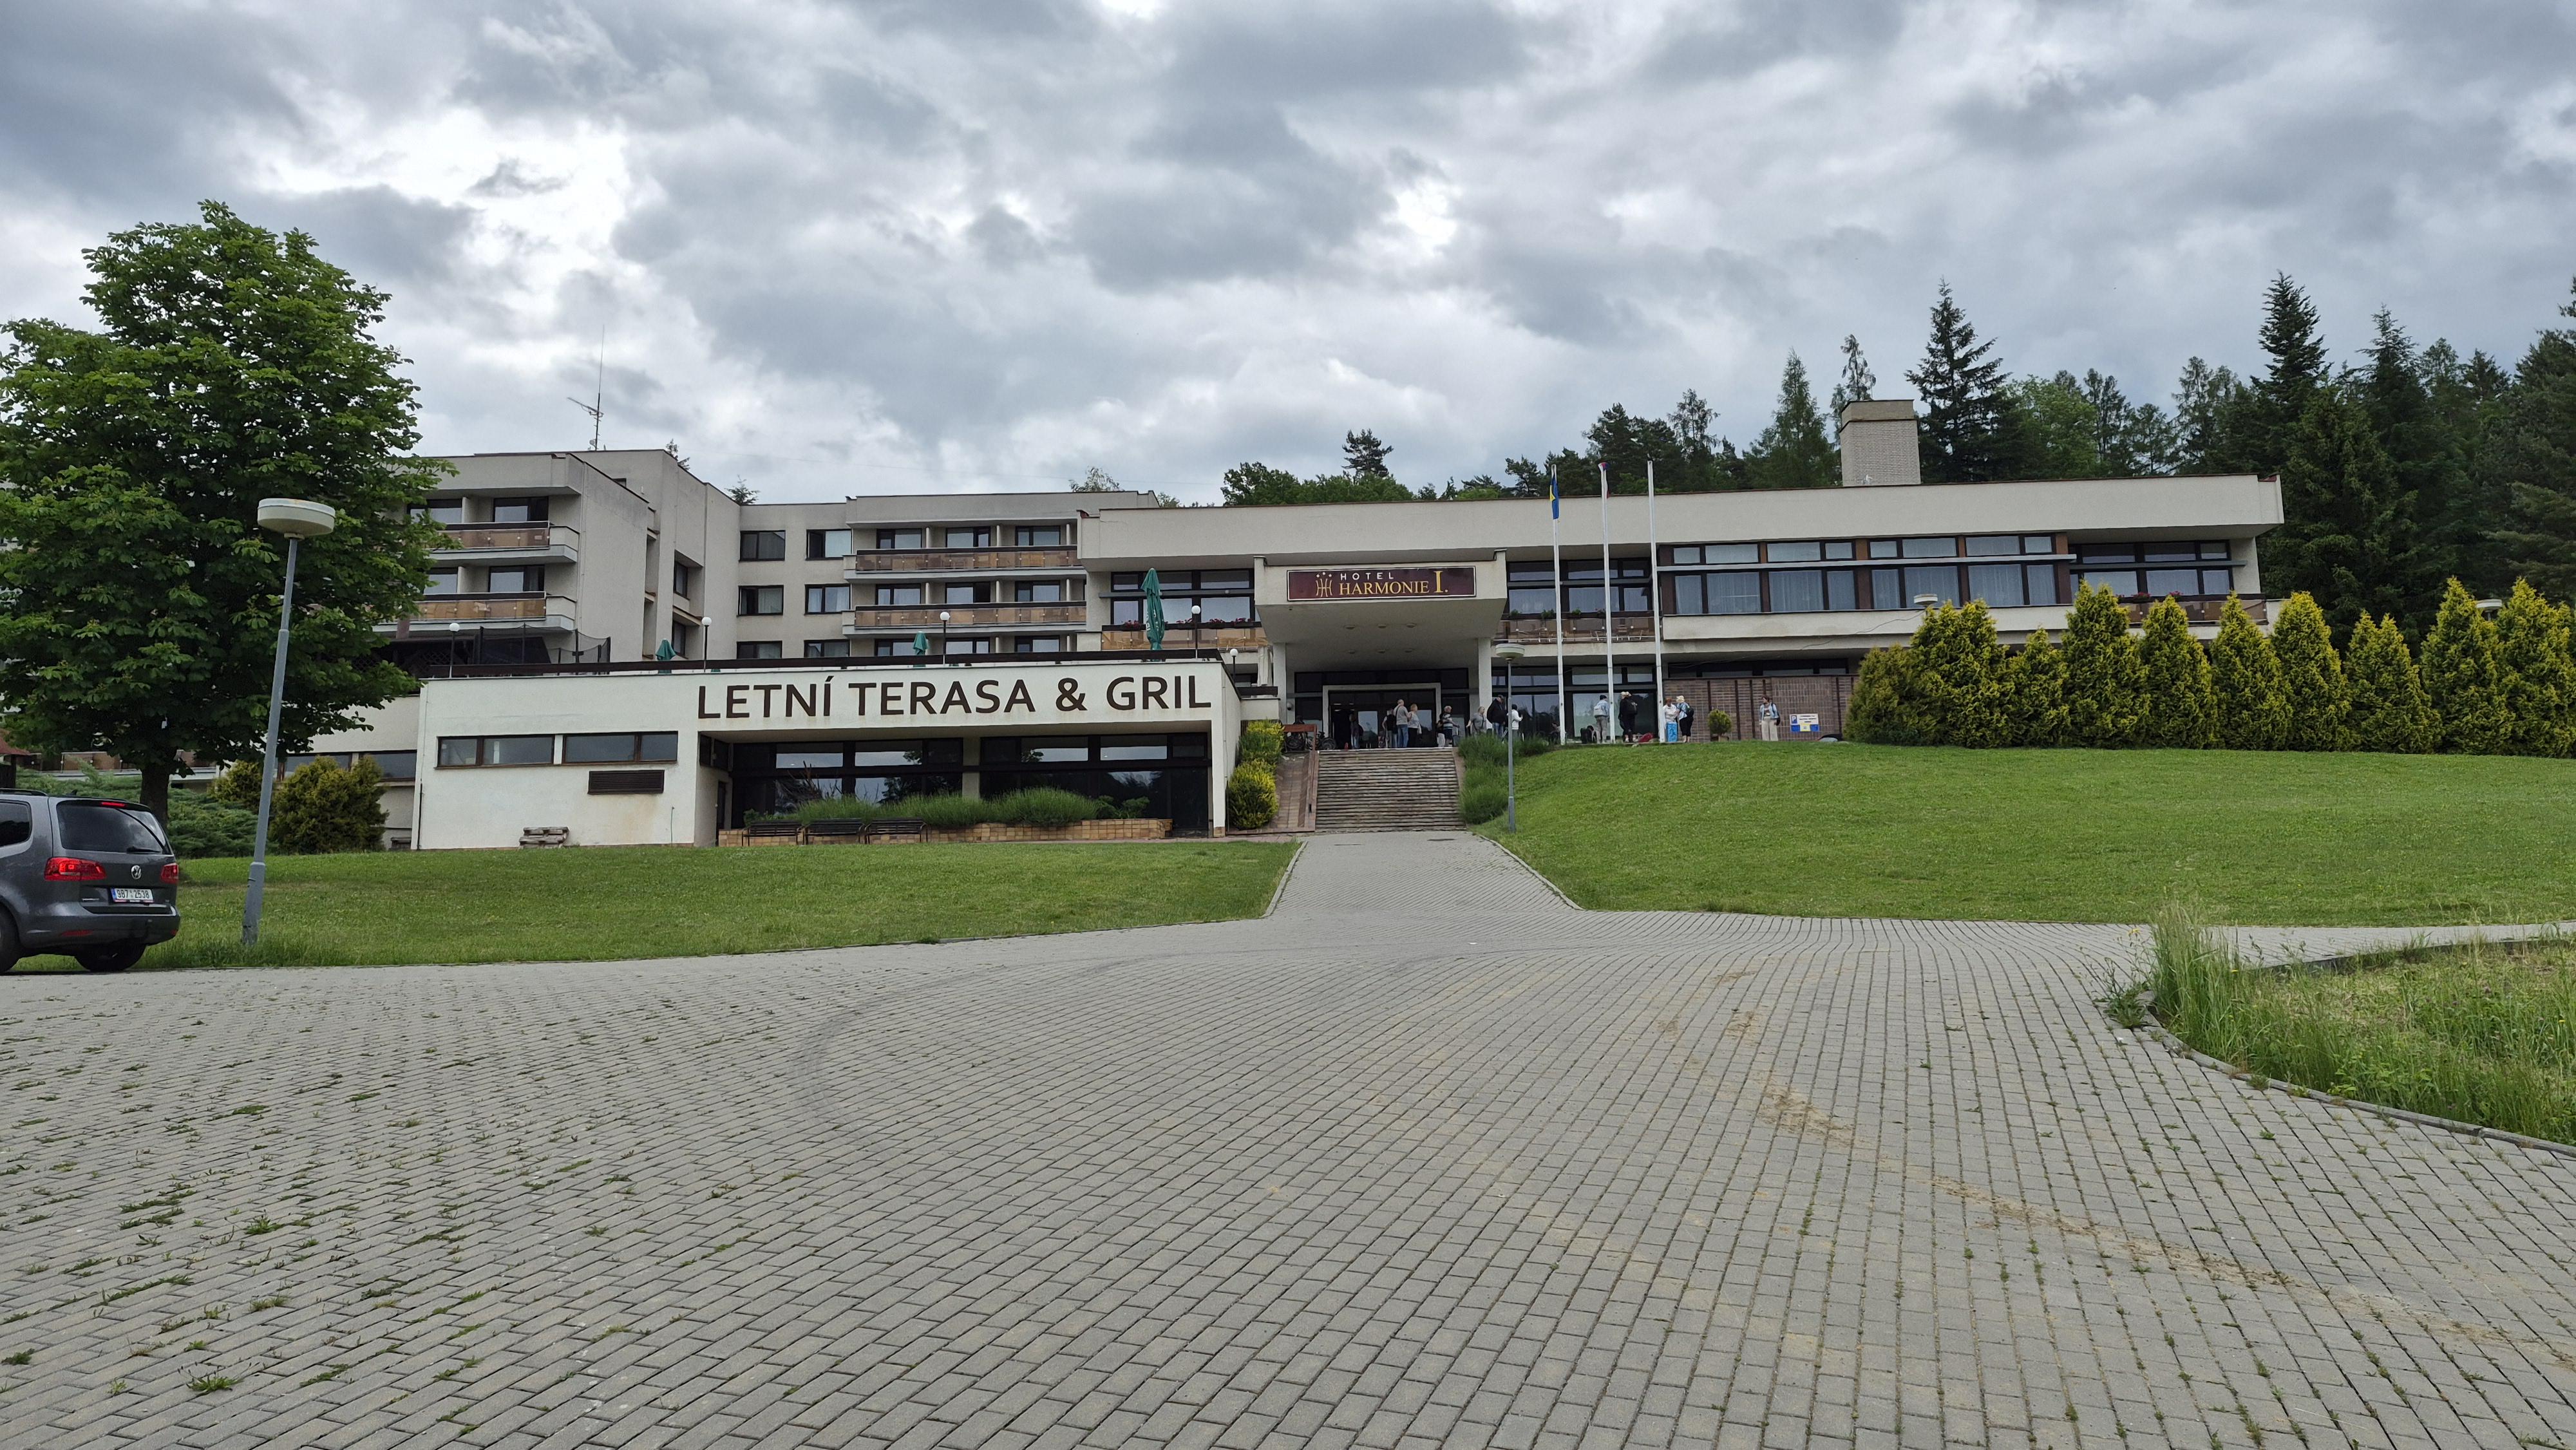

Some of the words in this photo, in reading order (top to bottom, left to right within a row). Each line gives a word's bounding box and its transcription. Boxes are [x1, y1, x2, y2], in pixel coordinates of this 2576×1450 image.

[1339, 581, 1429, 595] HARMONIE
[698, 675, 834, 719] LETNÍ
[848, 679, 1035, 715] TERASA
[1055, 677, 1087, 711] &
[1106, 675, 1211, 711] GRIL
